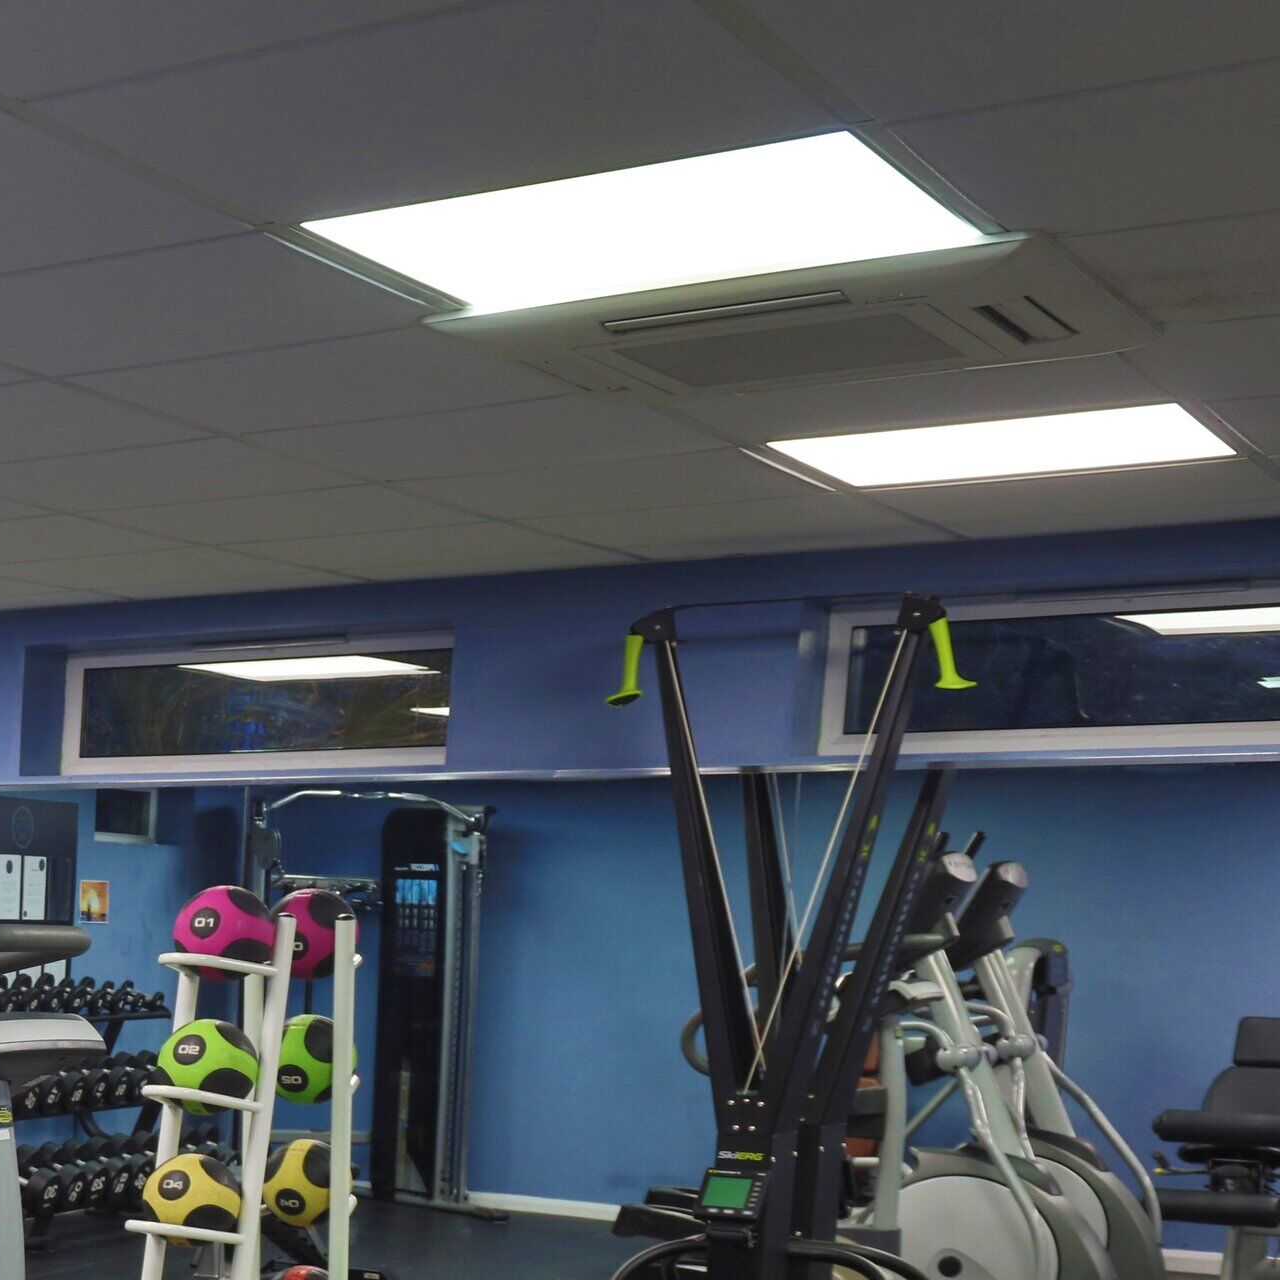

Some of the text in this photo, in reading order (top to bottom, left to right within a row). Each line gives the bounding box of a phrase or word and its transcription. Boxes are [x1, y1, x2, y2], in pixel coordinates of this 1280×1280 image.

[194, 917, 215, 928] 01
[178, 1044, 200, 1055] 02
[163, 1179, 184, 1190] 04
